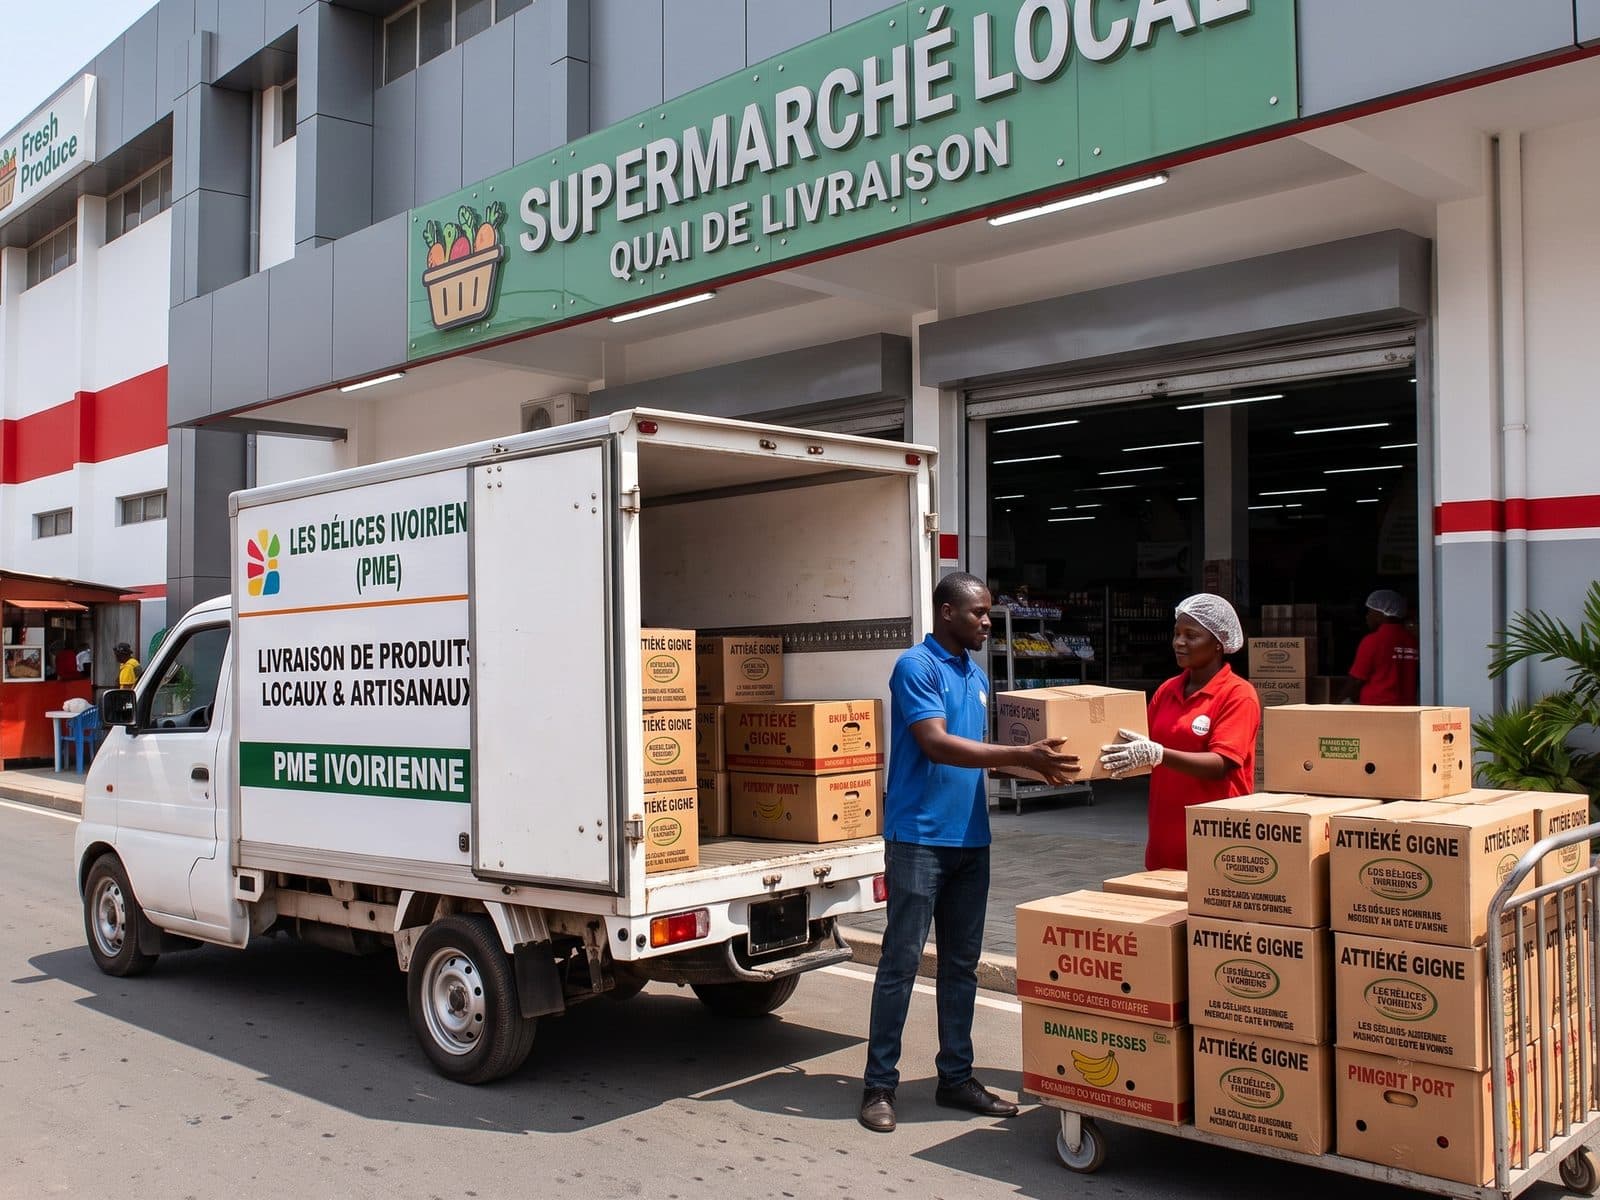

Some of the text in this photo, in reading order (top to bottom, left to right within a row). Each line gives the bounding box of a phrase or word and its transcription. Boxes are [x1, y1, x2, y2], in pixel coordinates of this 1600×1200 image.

[21, 112, 58, 162] Fresh
[519, 0, 1250, 252] SUPERMARCHÉ LOCA
[21, 134, 78, 193] Produce
[610, 119, 1011, 281] QUAI DE LIVRAISON
[290, 501, 467, 556] LES DÉLICES IVOIRIEN
[356, 553, 402, 595] (PME)
[258, 645, 345, 673] LIVRAISON
[351, 643, 374, 669] DE
[668, 639, 692, 650] GIGNE
[262, 680, 327, 707] LOCAUX
[333, 679, 346, 706] &
[739, 710, 797, 728] ATTIÉKÉ
[750, 731, 787, 746] GIGNE
[274, 751, 465, 793] PME IVOIRIENNE
[669, 797, 694, 812] GIGNE
[1193, 817, 1302, 843] ATTIÉKÉ GIGNE
[1336, 828, 1459, 857] ATTIÉKÉ GIGNE
[1042, 925, 1138, 957] ATTIÉKÉ
[1193, 930, 1304, 959] ATTIÉKÉ GIGNE
[1058, 954, 1123, 982] GIGNE
[1341, 947, 1466, 980] ATTIÉKÉ GIGNE
[1044, 1021, 1098, 1043] BANANES
[1101, 1032, 1147, 1053] PESSES
[1199, 1036, 1309, 1071] ATTIÉKÉ GIGNE
[1412, 1075, 1455, 1098] PORT
